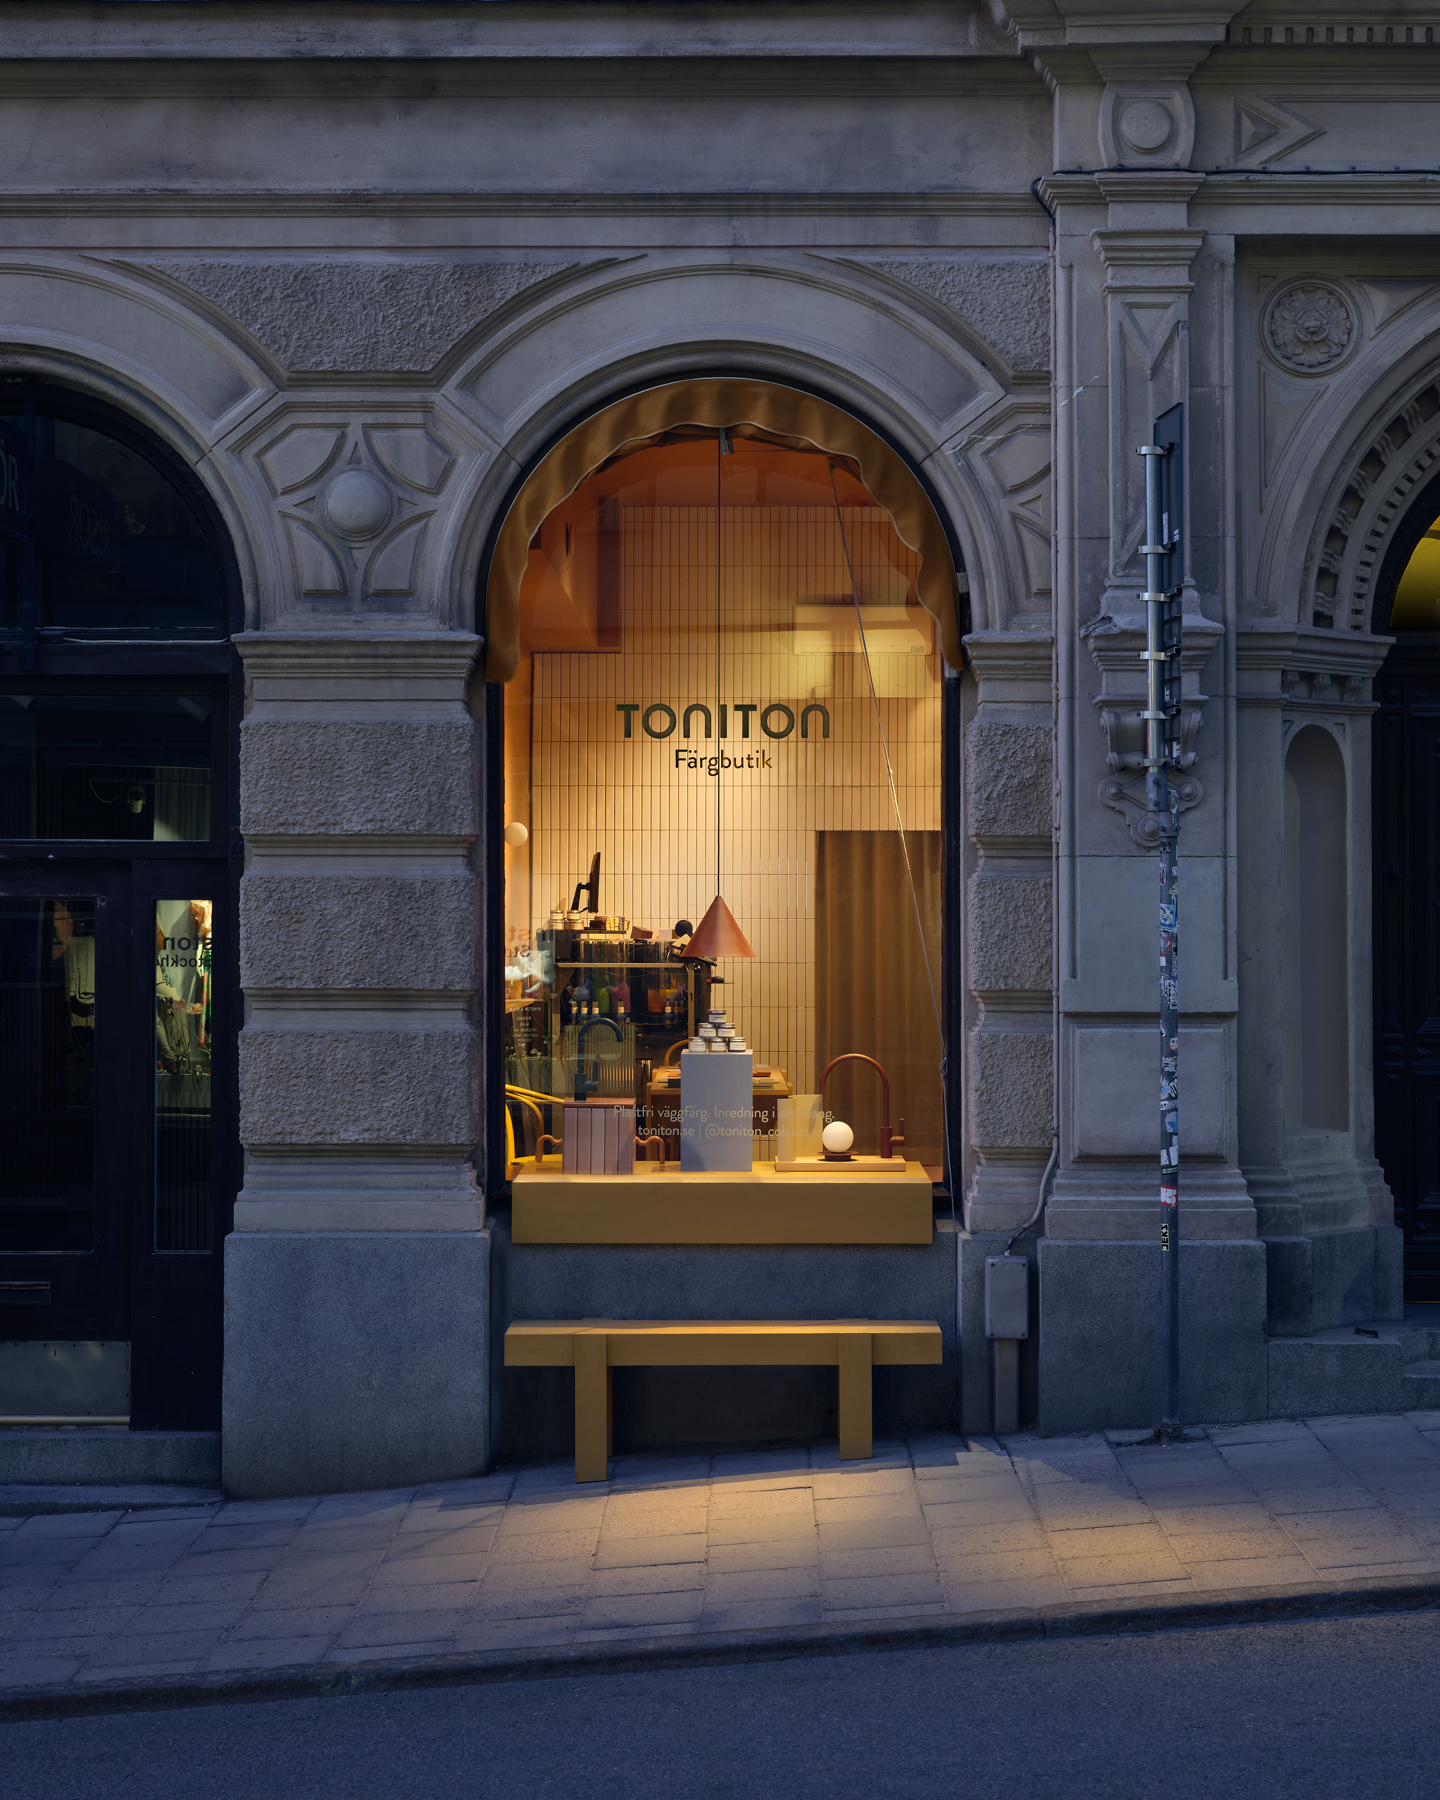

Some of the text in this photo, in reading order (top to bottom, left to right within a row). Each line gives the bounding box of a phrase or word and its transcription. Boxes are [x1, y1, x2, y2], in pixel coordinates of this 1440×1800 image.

[616, 703, 830, 739] TONITON
[674, 749, 773, 776] Färgbutik
[613, 1105, 654, 1118] Plastfri
[657, 1105, 710, 1123] väggfärg.
[714, 1106, 769, 1123] Inredning
[772, 1106, 776, 1119] i
[638, 1123, 696, 1136] toniton.se
